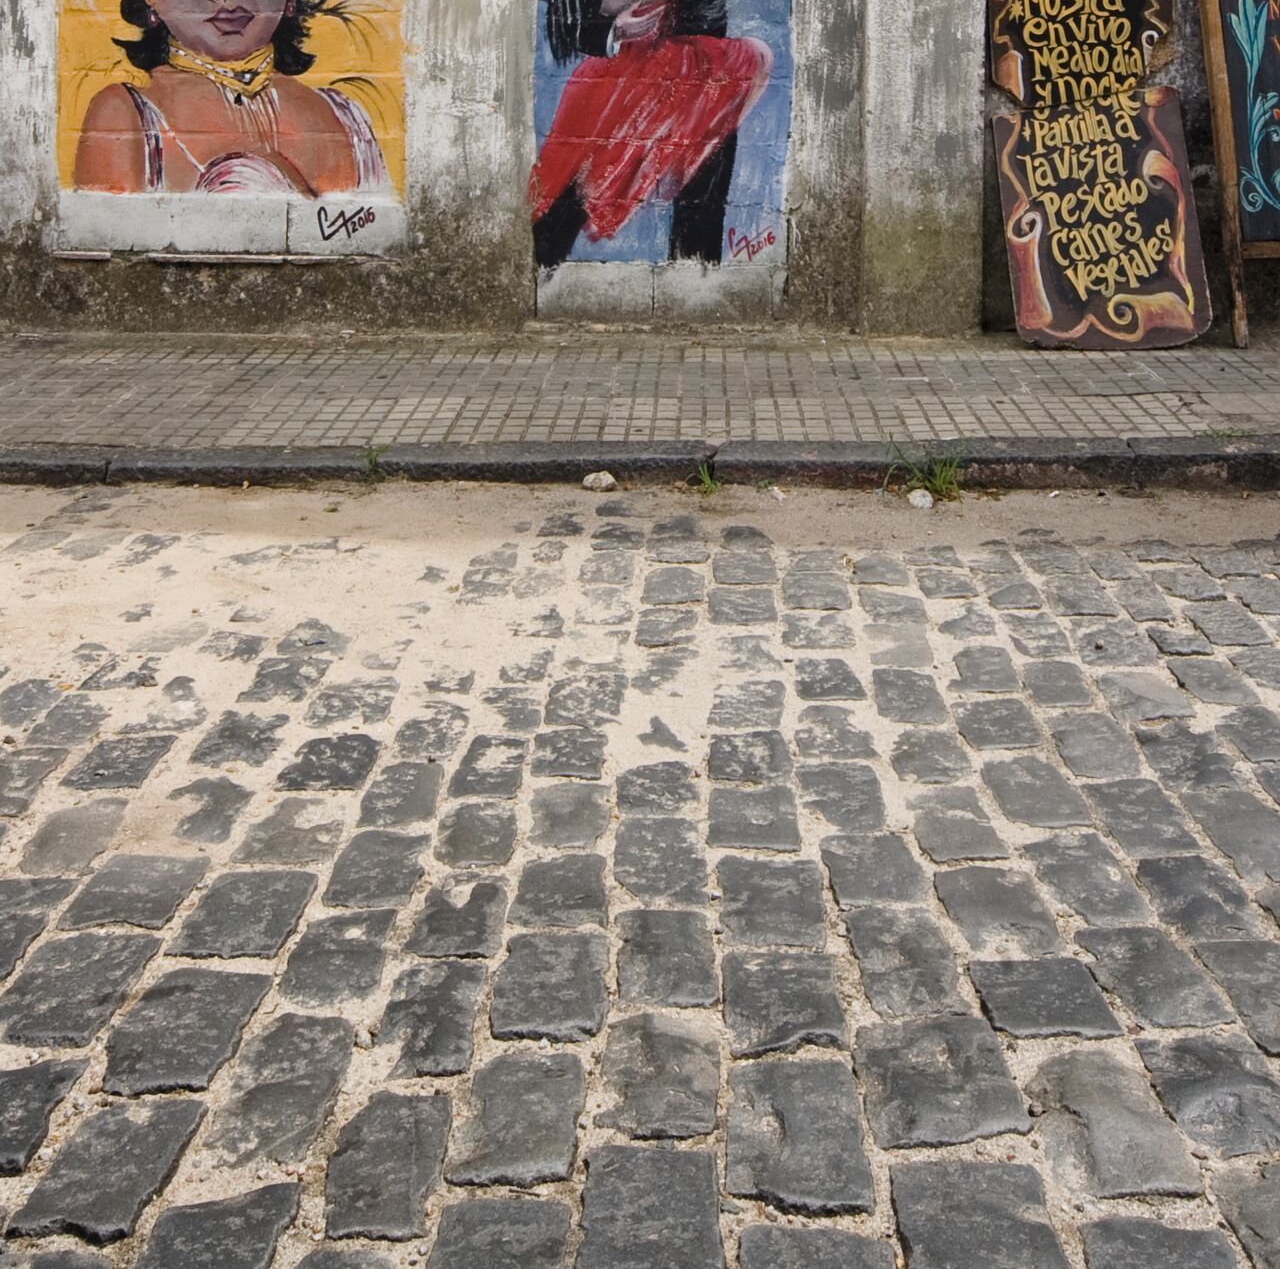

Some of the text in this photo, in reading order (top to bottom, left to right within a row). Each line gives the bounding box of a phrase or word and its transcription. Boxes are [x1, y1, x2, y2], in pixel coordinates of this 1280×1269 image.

[1023, 17, 1069, 48] en
[1029, 44, 1110, 81] Medio
[1033, 71, 1141, 120] y noche
[1031, 106, 1141, 155] Parrilla a
[1016, 153, 1056, 198] la
[1038, 175, 1149, 235] Pescado
[750, 231, 776, 256] 2016
